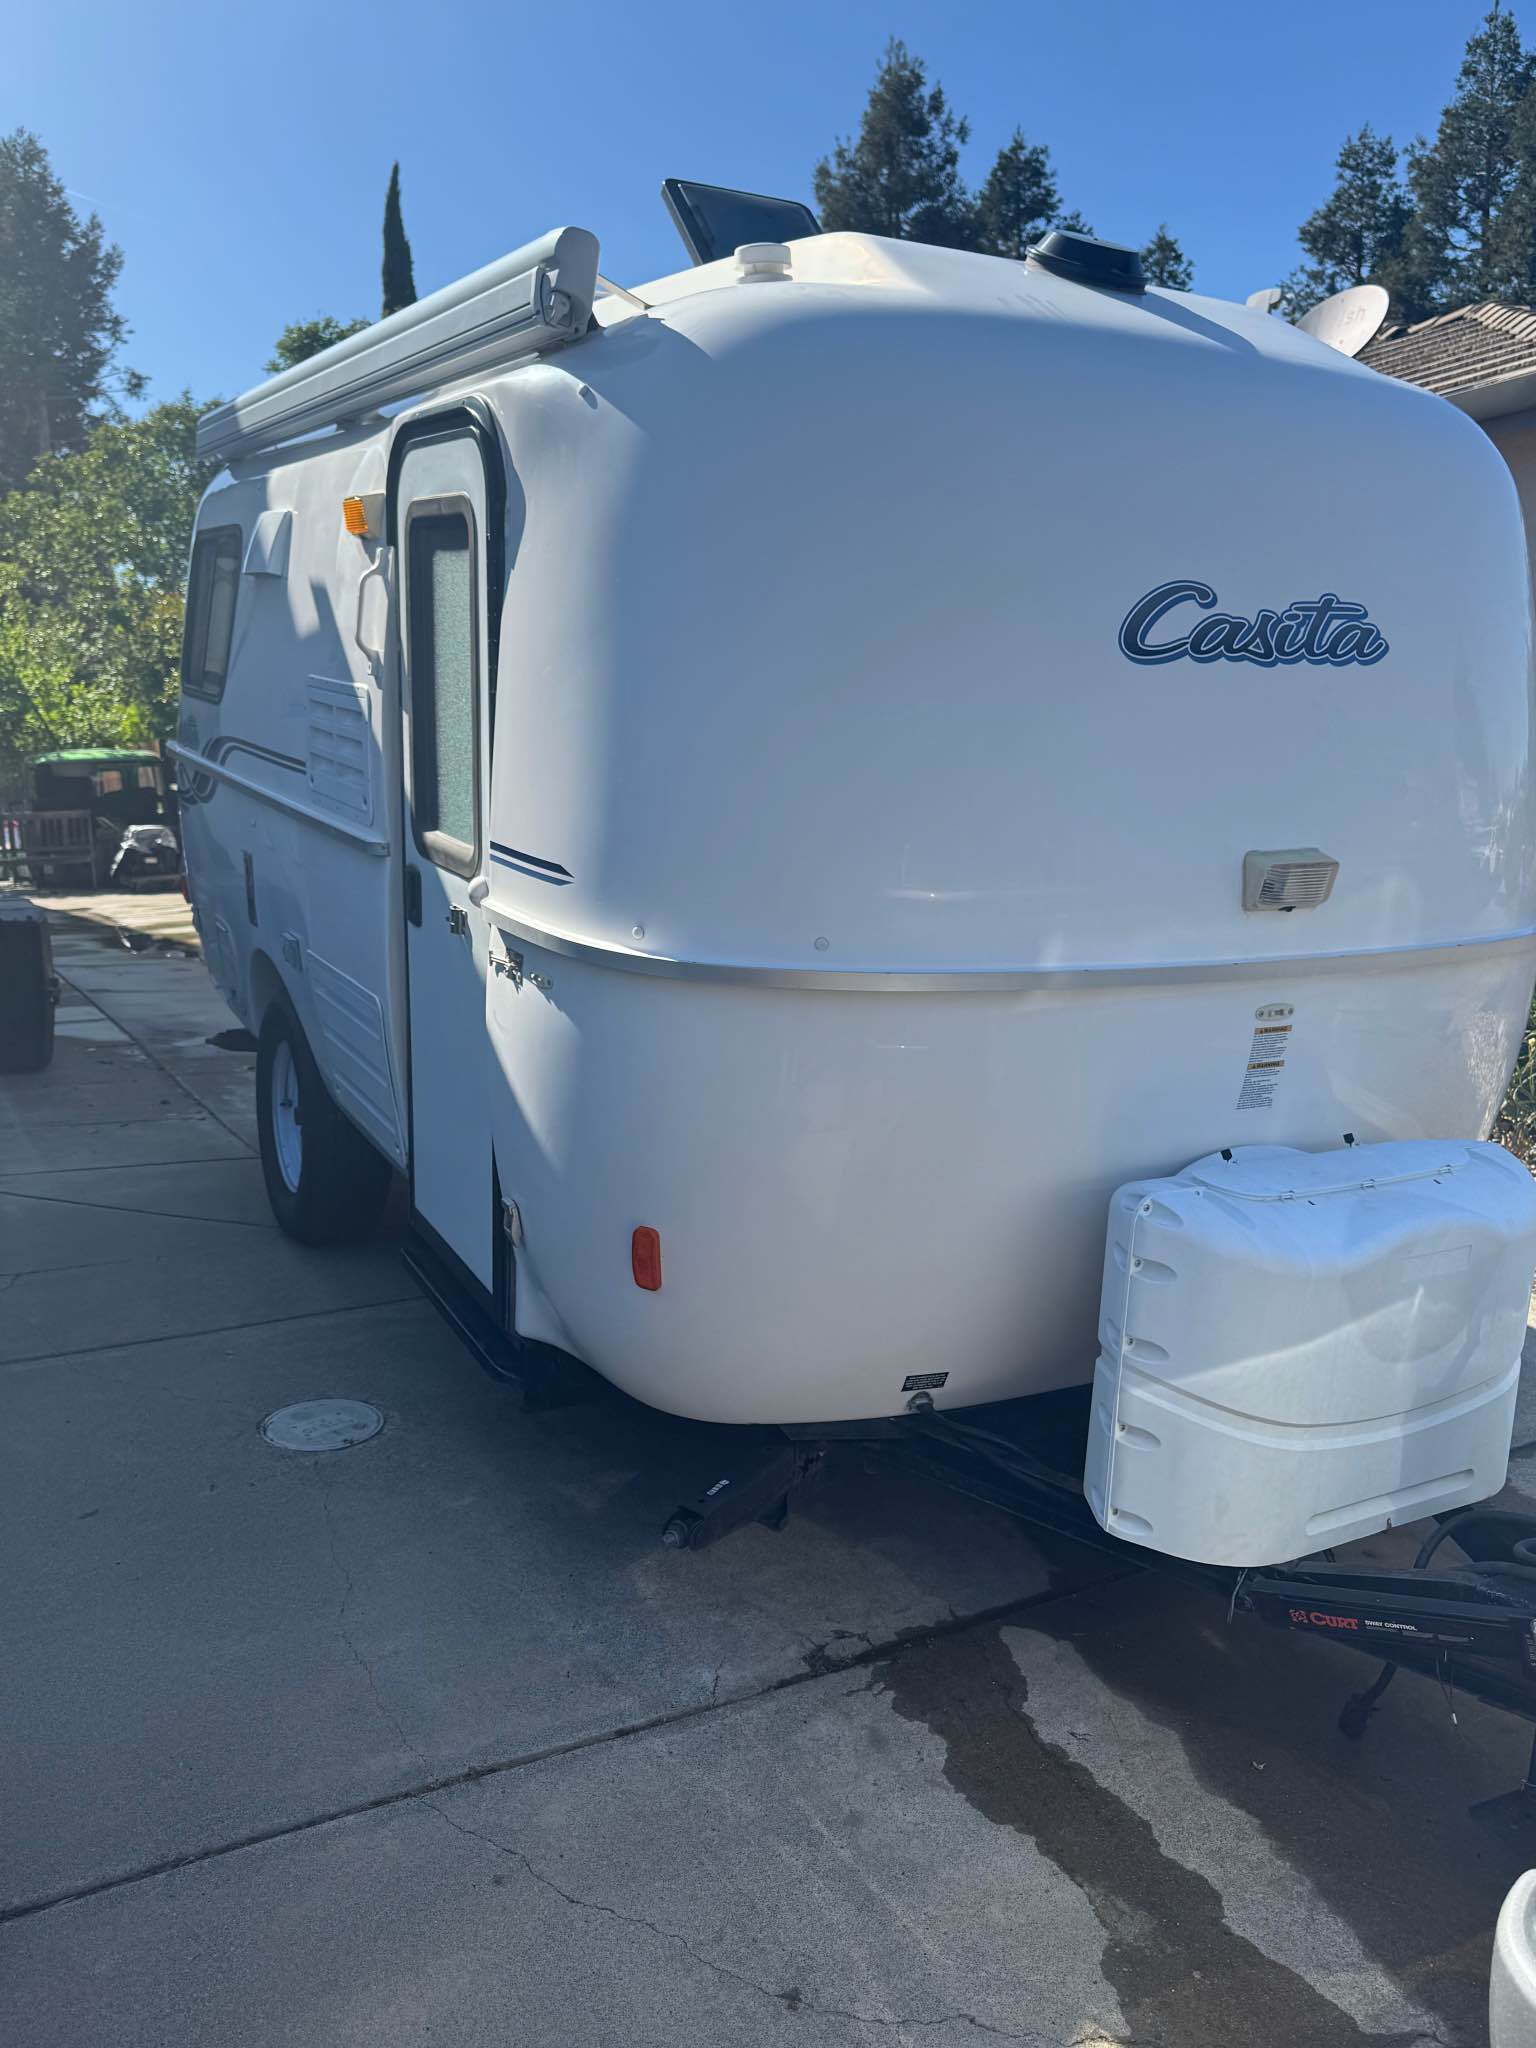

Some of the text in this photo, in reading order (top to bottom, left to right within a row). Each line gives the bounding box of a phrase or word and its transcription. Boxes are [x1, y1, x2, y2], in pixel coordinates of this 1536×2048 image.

[1118, 580, 1389, 667] Casita
[1310, 1612, 1359, 1630] CURT
[1384, 1622, 1418, 1631] CONTROL
